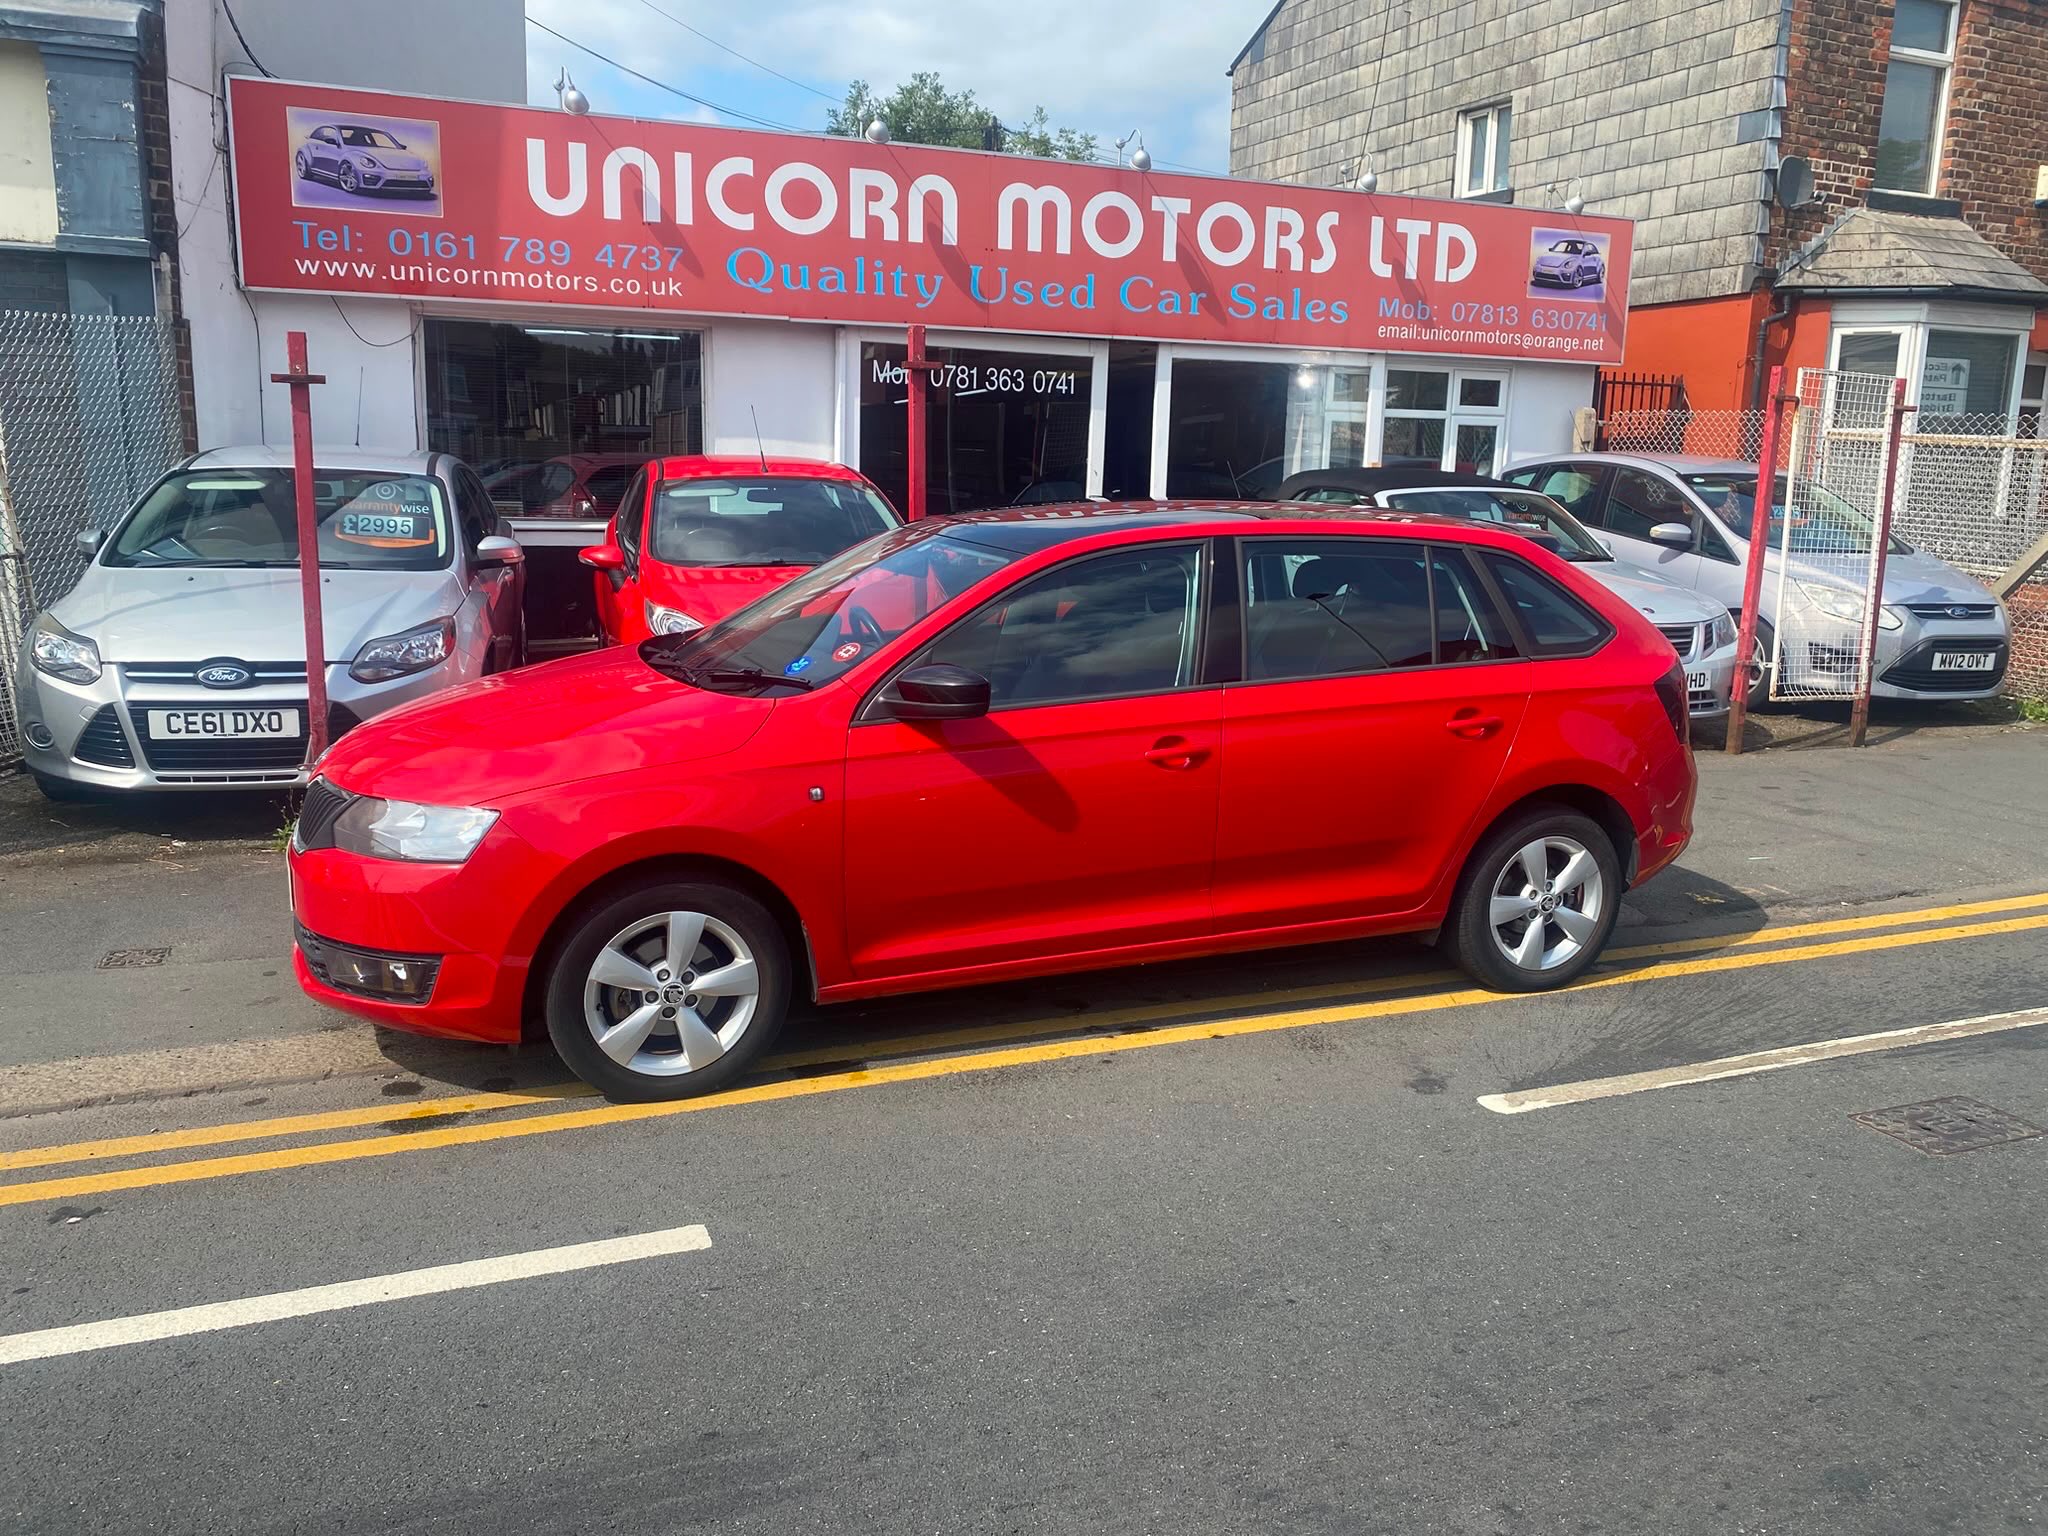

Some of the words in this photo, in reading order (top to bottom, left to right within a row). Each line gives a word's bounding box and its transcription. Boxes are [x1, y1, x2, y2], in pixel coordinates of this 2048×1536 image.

[525, 137, 958, 246] UNICORN
[997, 182, 1340, 273] MOTORS
[1369, 215, 1478, 283] LTD
[292, 220, 363, 253] Tel:
[388, 228, 475, 260] 0161
[499, 236, 571, 266] 789
[594, 243, 683, 272] 4737
[294, 258, 683, 297] www.unicornmotors.co.uk
[726, 247, 943, 308] Quality
[969, 265, 1096, 310] Used
[1119, 275, 1207, 315] Car
[1228, 283, 1349, 323] Sales
[1378, 297, 1438, 321] Mob:
[1451, 302, 1518, 326] 07813
[1531, 308, 1608, 332] 630741
[1378, 323, 1604, 352] email:unicornmotors@orange.net
[930, 364, 977, 389] 0781
[985, 367, 1025, 392] 363
[1033, 370, 1075, 395] 0741
[343, 514, 412, 535] £2995
[208, 669, 237, 681] Ford
[1939, 655, 1965, 668] MV12
[1686, 672, 1706, 689] HD
[166, 711, 225, 734] CE61
[233, 711, 283, 733] DXO
